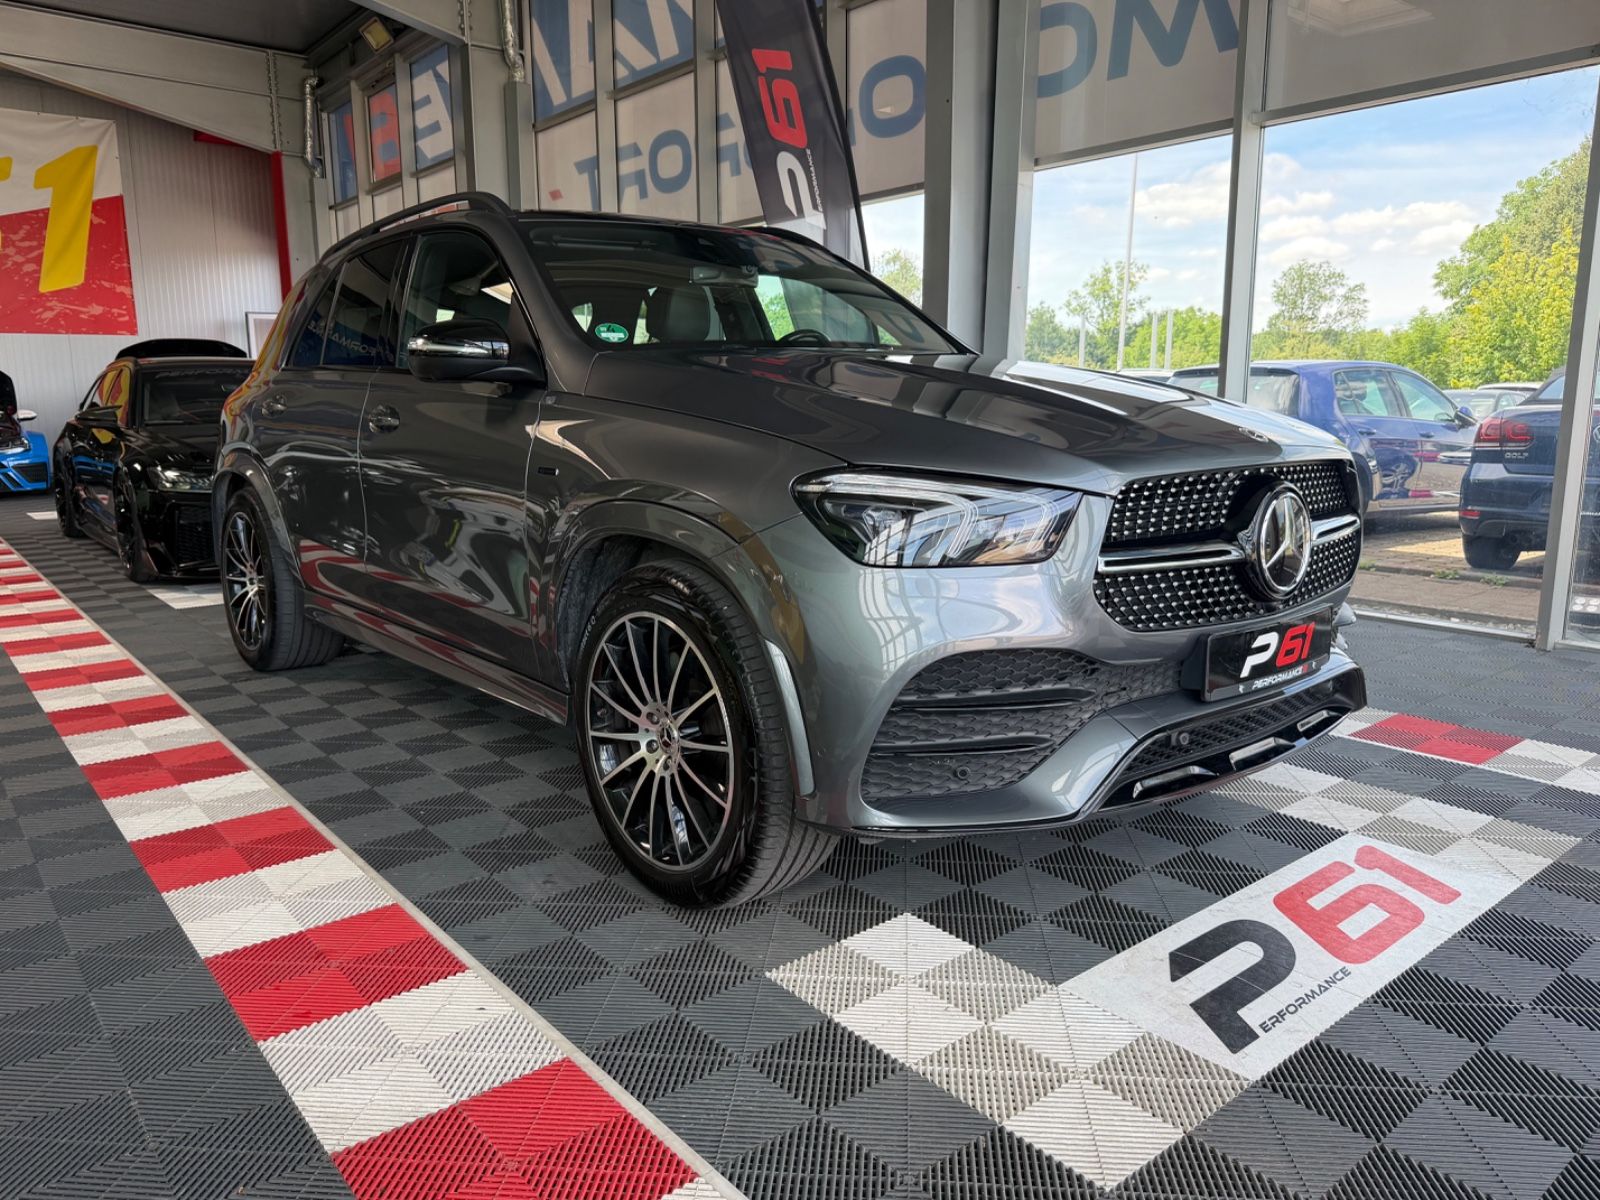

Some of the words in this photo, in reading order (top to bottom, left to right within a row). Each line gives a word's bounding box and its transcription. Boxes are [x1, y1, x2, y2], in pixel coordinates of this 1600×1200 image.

[752, 48, 826, 229] P61
[1504, 452, 1529, 460] GOLF
[1240, 621, 1316, 679] P61
[1169, 845, 1462, 1054] P61
